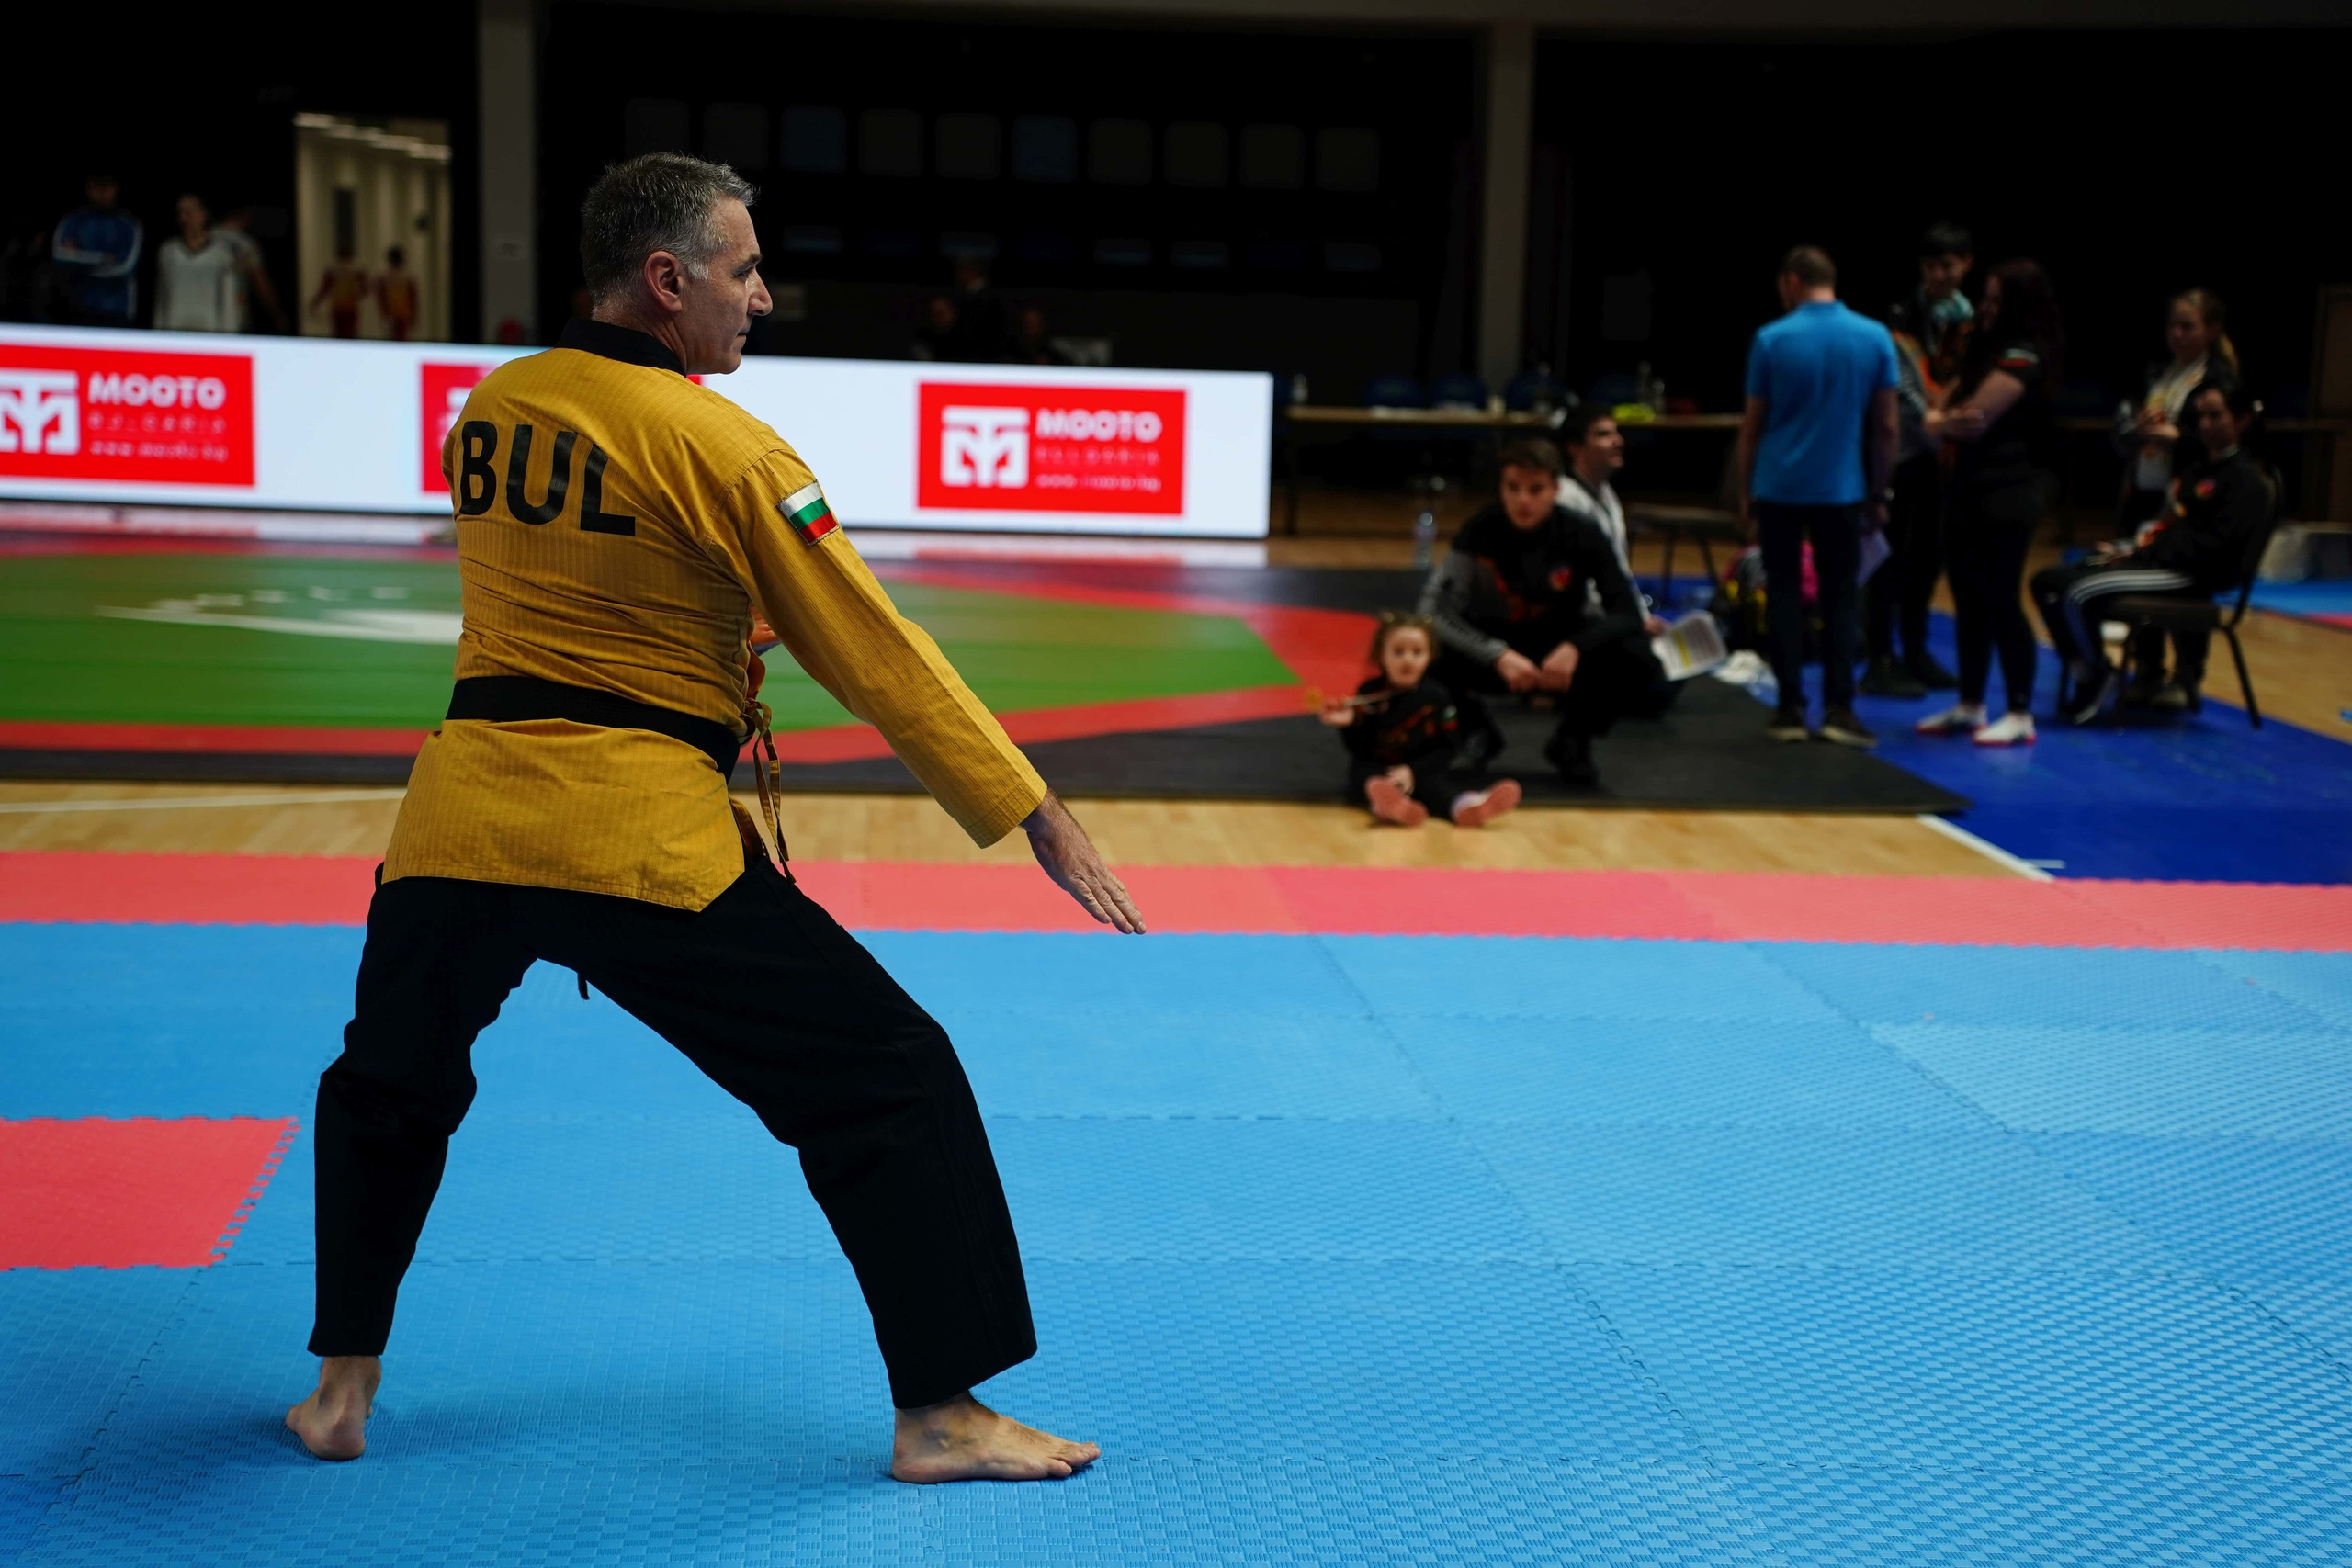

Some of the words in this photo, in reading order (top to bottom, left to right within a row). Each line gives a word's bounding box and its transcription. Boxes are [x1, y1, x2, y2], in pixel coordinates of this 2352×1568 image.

[88, 371, 227, 410] MOOTO
[1035, 408, 1163, 443] MOOTO
[459, 420, 636, 536] BUL
